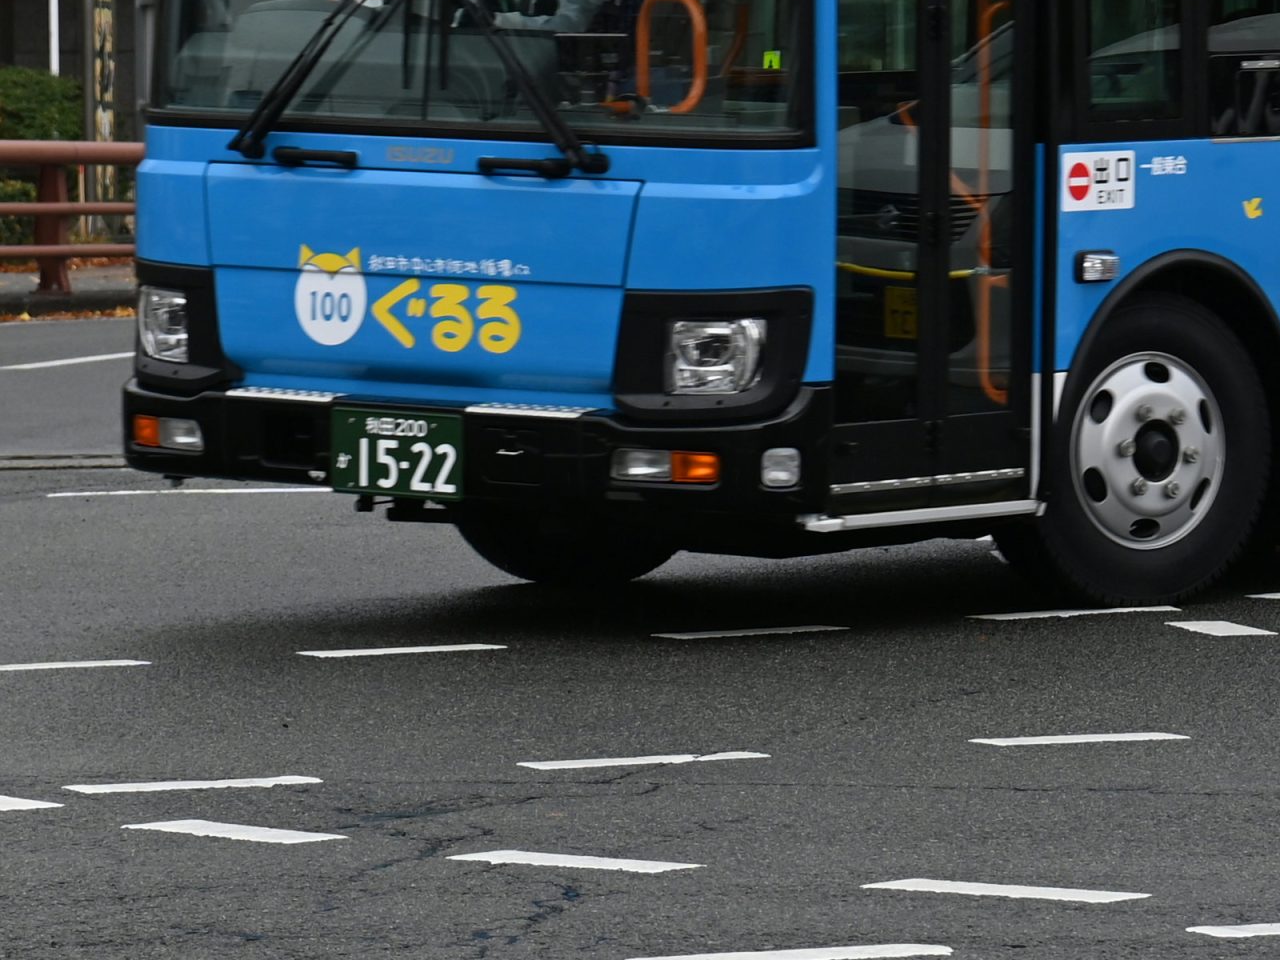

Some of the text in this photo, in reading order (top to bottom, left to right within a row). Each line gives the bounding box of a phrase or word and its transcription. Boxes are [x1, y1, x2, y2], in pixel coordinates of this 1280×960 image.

[1094, 157, 1131, 184] 出口
[1097, 189, 1125, 204] EXIT
[309, 291, 353, 323] 100
[371, 277, 522, 354] ぐるる
[358, 437, 457, 493] 15-22
